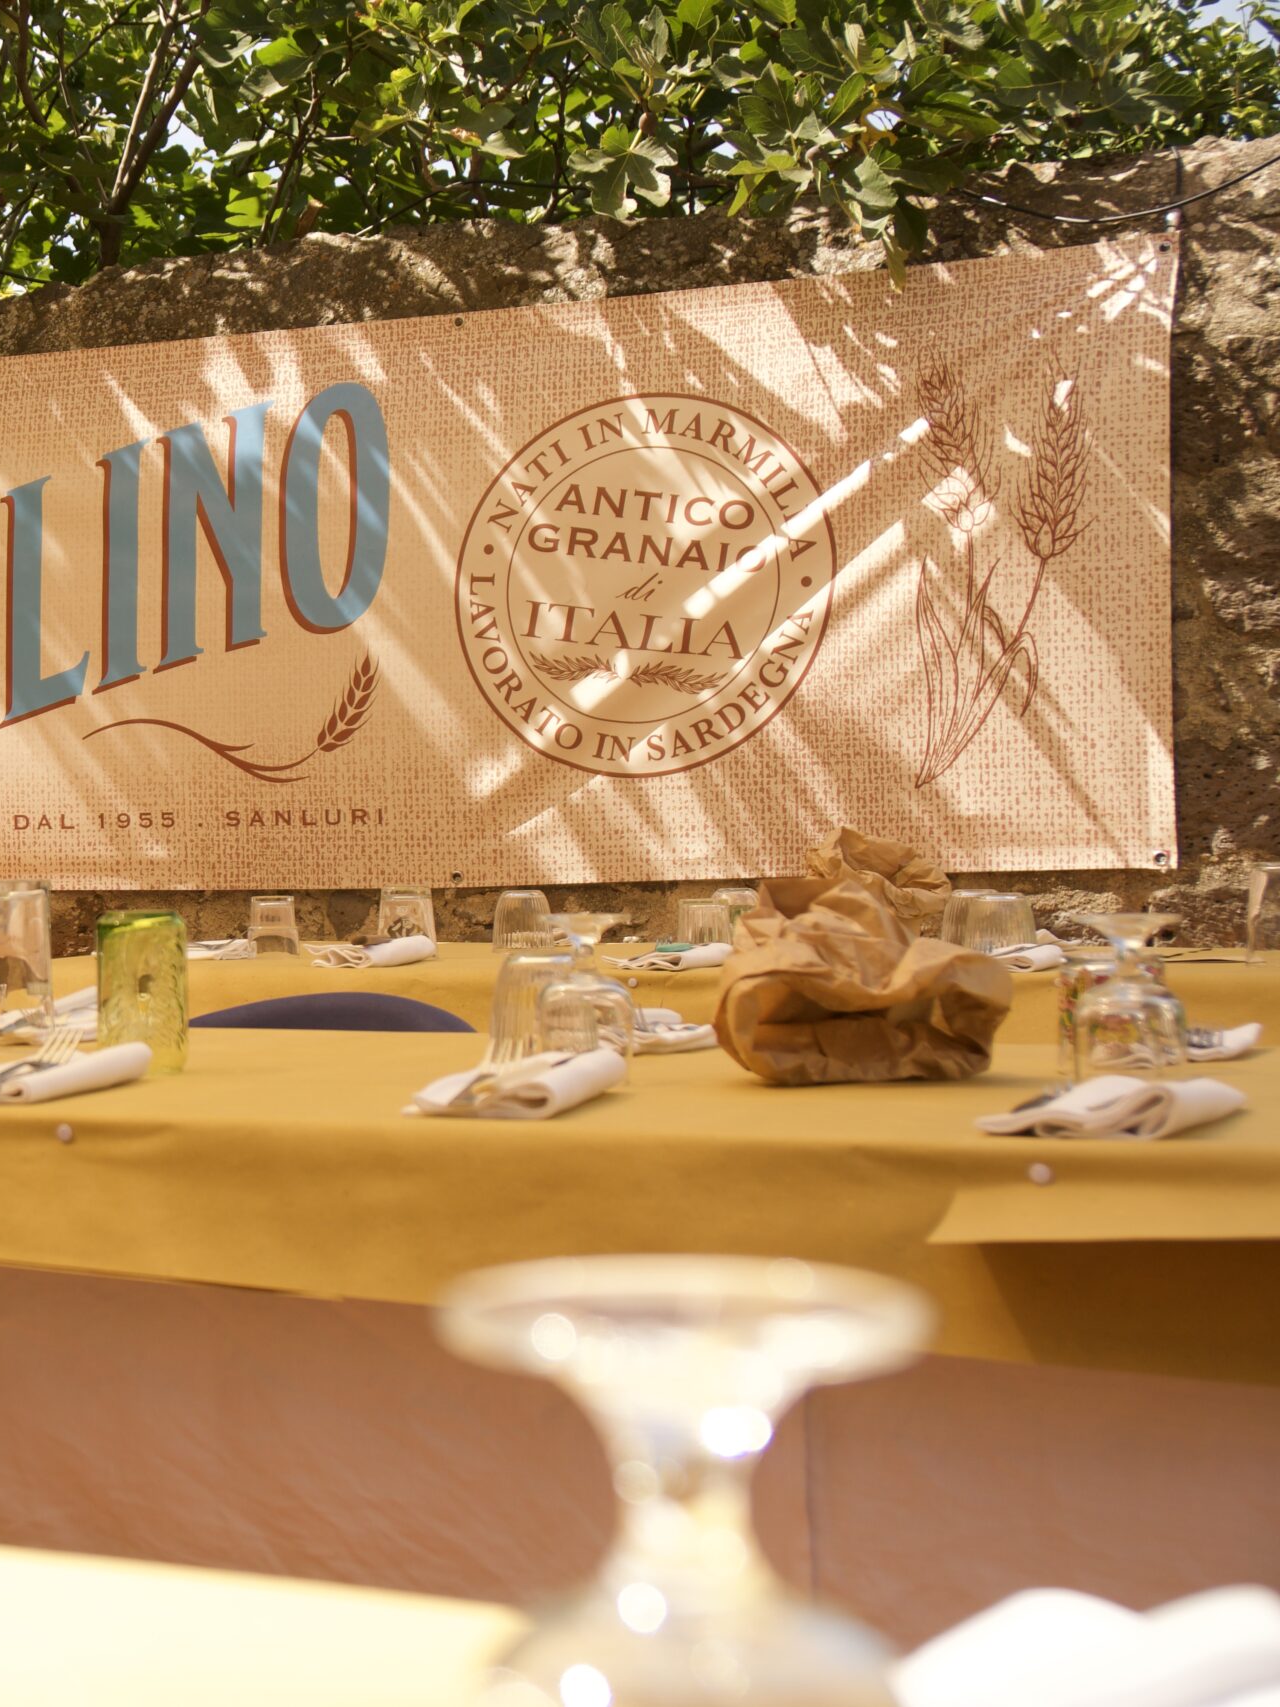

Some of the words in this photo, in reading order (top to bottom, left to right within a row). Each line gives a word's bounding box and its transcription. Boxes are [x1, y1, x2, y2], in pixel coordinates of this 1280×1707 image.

[488, 438, 572, 533] NATI
[578, 412, 624, 451] IN
[554, 483, 755, 530] ANTICO
[527, 523, 767, 573] GRANAIO
[616, 572, 663, 602] di
[520, 599, 745, 660] ITALIA
[470, 572, 583, 750] LAVORATO
[592, 732, 637, 763] IN
[645, 607, 815, 762] SARDEGNA
[13, 813, 75, 831] DAL
[97, 811, 177, 829] 1955
[225, 807, 387, 828] SANLURI
